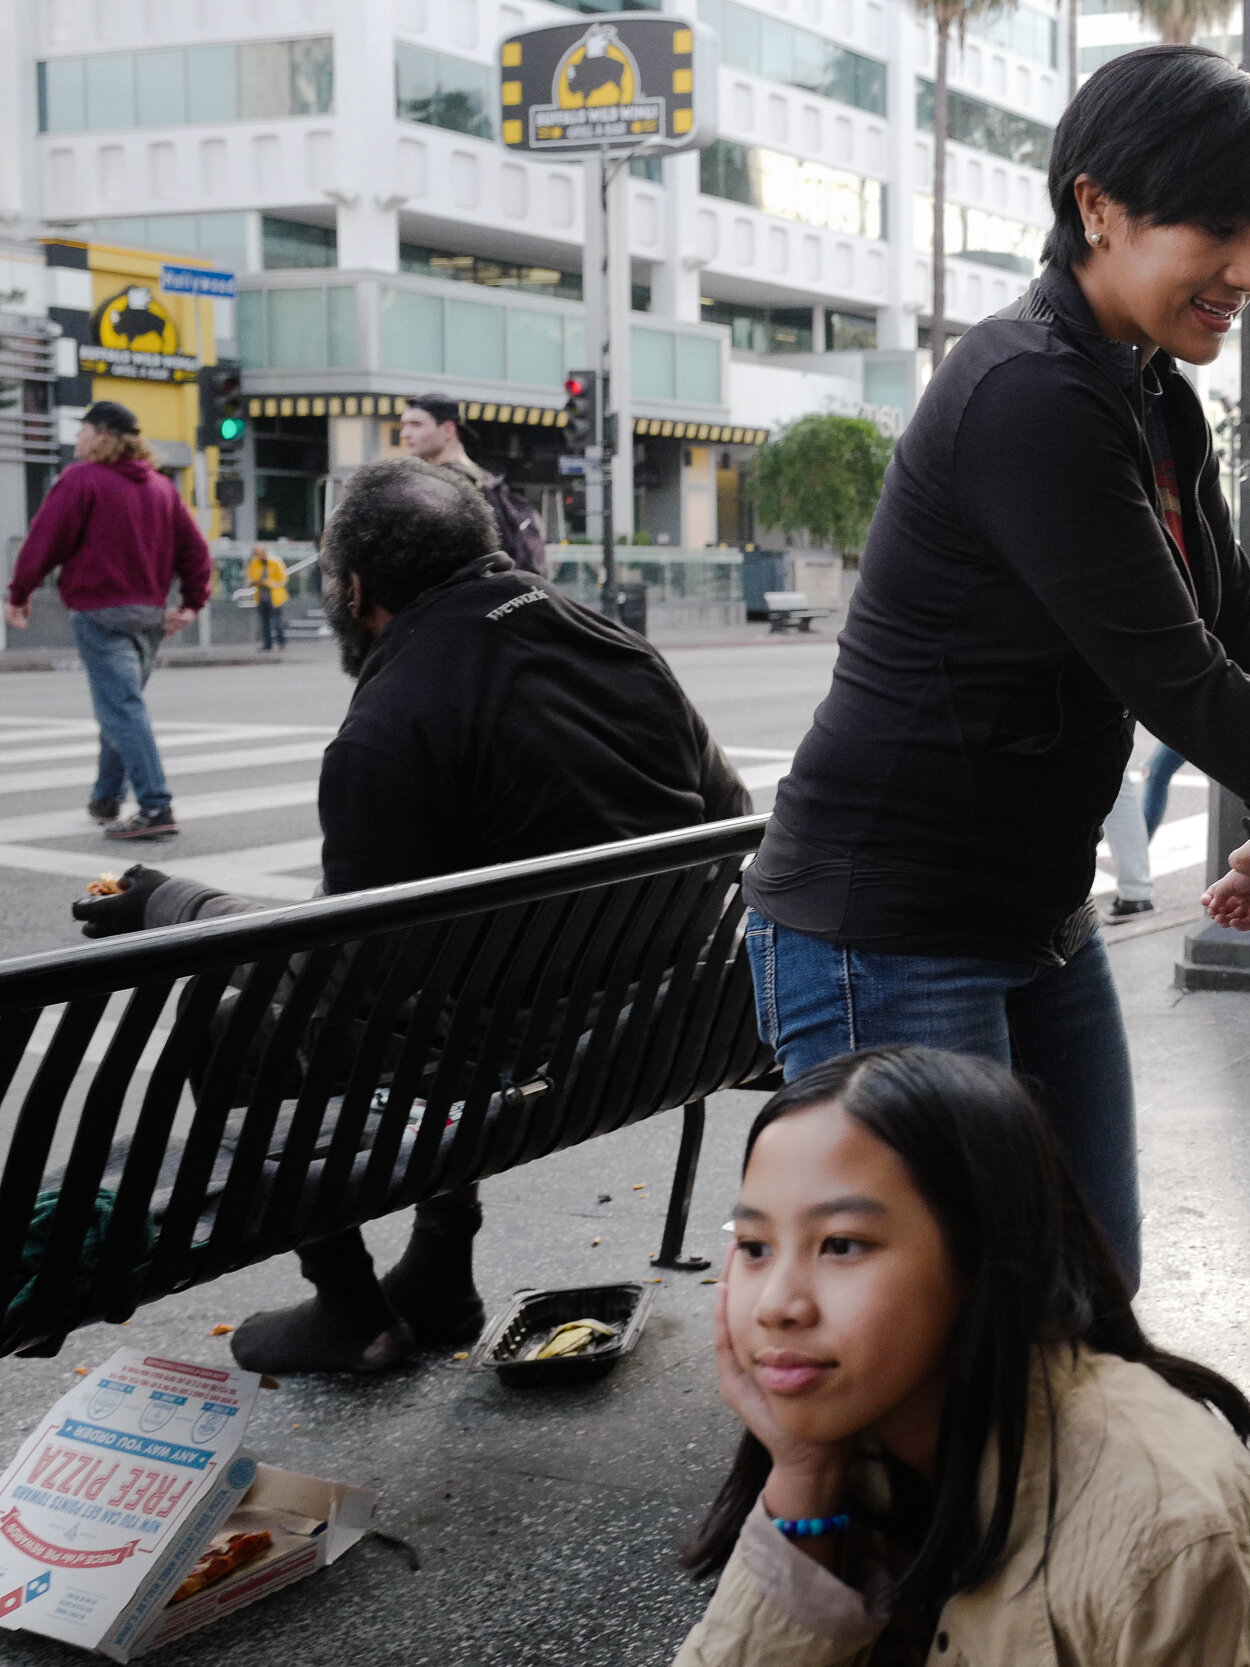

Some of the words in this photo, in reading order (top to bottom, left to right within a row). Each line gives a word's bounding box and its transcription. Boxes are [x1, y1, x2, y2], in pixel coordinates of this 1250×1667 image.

[73, 1425, 117, 1445] ORDER
[116, 1436, 142, 1452] YOU
[143, 1443, 171, 1457] WAY
[170, 1449, 199, 1463] ANY
[26, 1446, 120, 1501] PIZZA
[11, 1484, 52, 1507] TOWARD
[108, 1468, 193, 1518] FREE
[49, 1495, 85, 1516] POINTS
[80, 1504, 102, 1520] GET
[99, 1509, 122, 1526] CAN
[119, 1513, 140, 1529] YOU
[138, 1518, 163, 1534] NOW
[6, 1523, 48, 1556] REWARDS
[43, 1548, 63, 1562] PIE
[84, 1552, 120, 1565] PIECE
